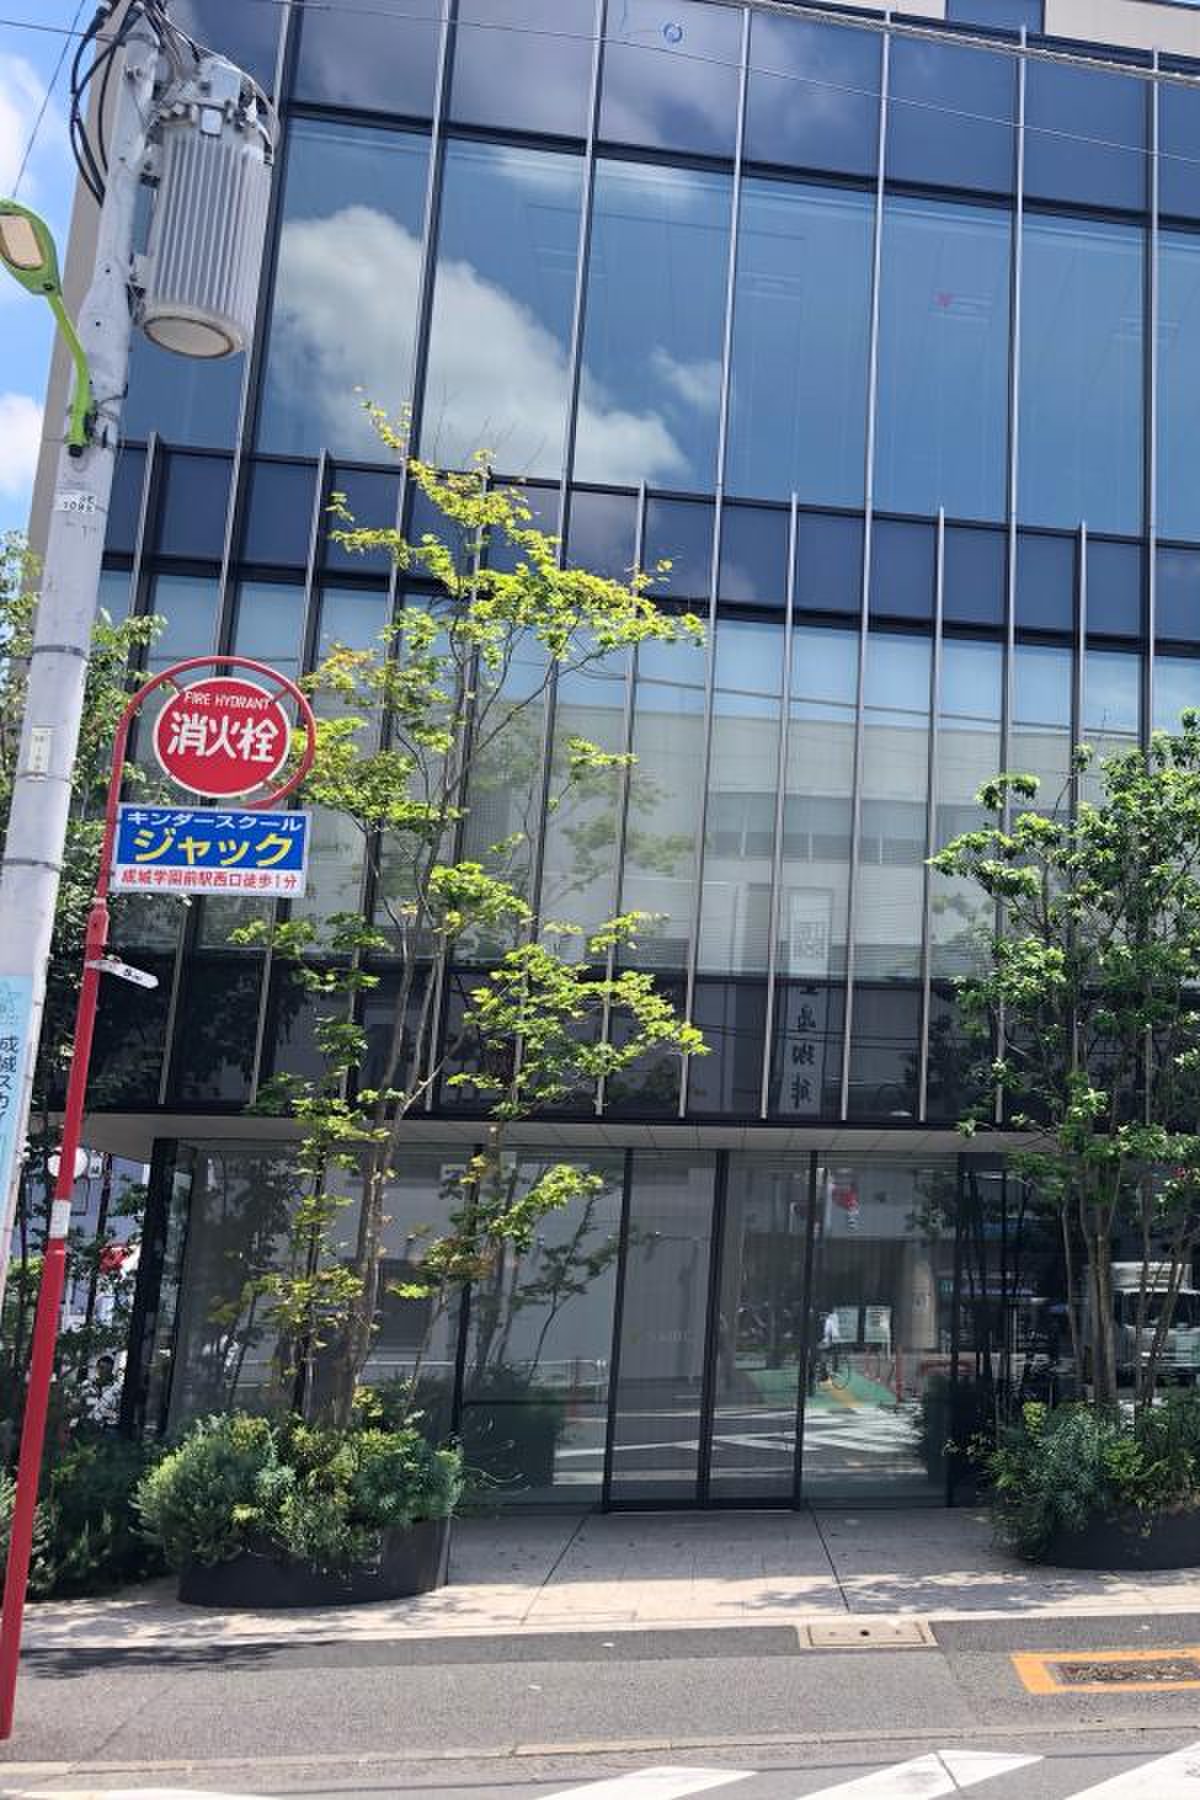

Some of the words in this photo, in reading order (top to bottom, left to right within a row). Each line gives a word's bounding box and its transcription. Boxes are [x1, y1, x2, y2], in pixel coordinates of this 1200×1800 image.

[184, 690, 211, 706] FIRE
[214, 694, 271, 710] HYDRANT
[166, 711, 279, 763] 消火栓
[127, 812, 303, 831] キンダースクール
[133, 828, 292, 867] ジャック
